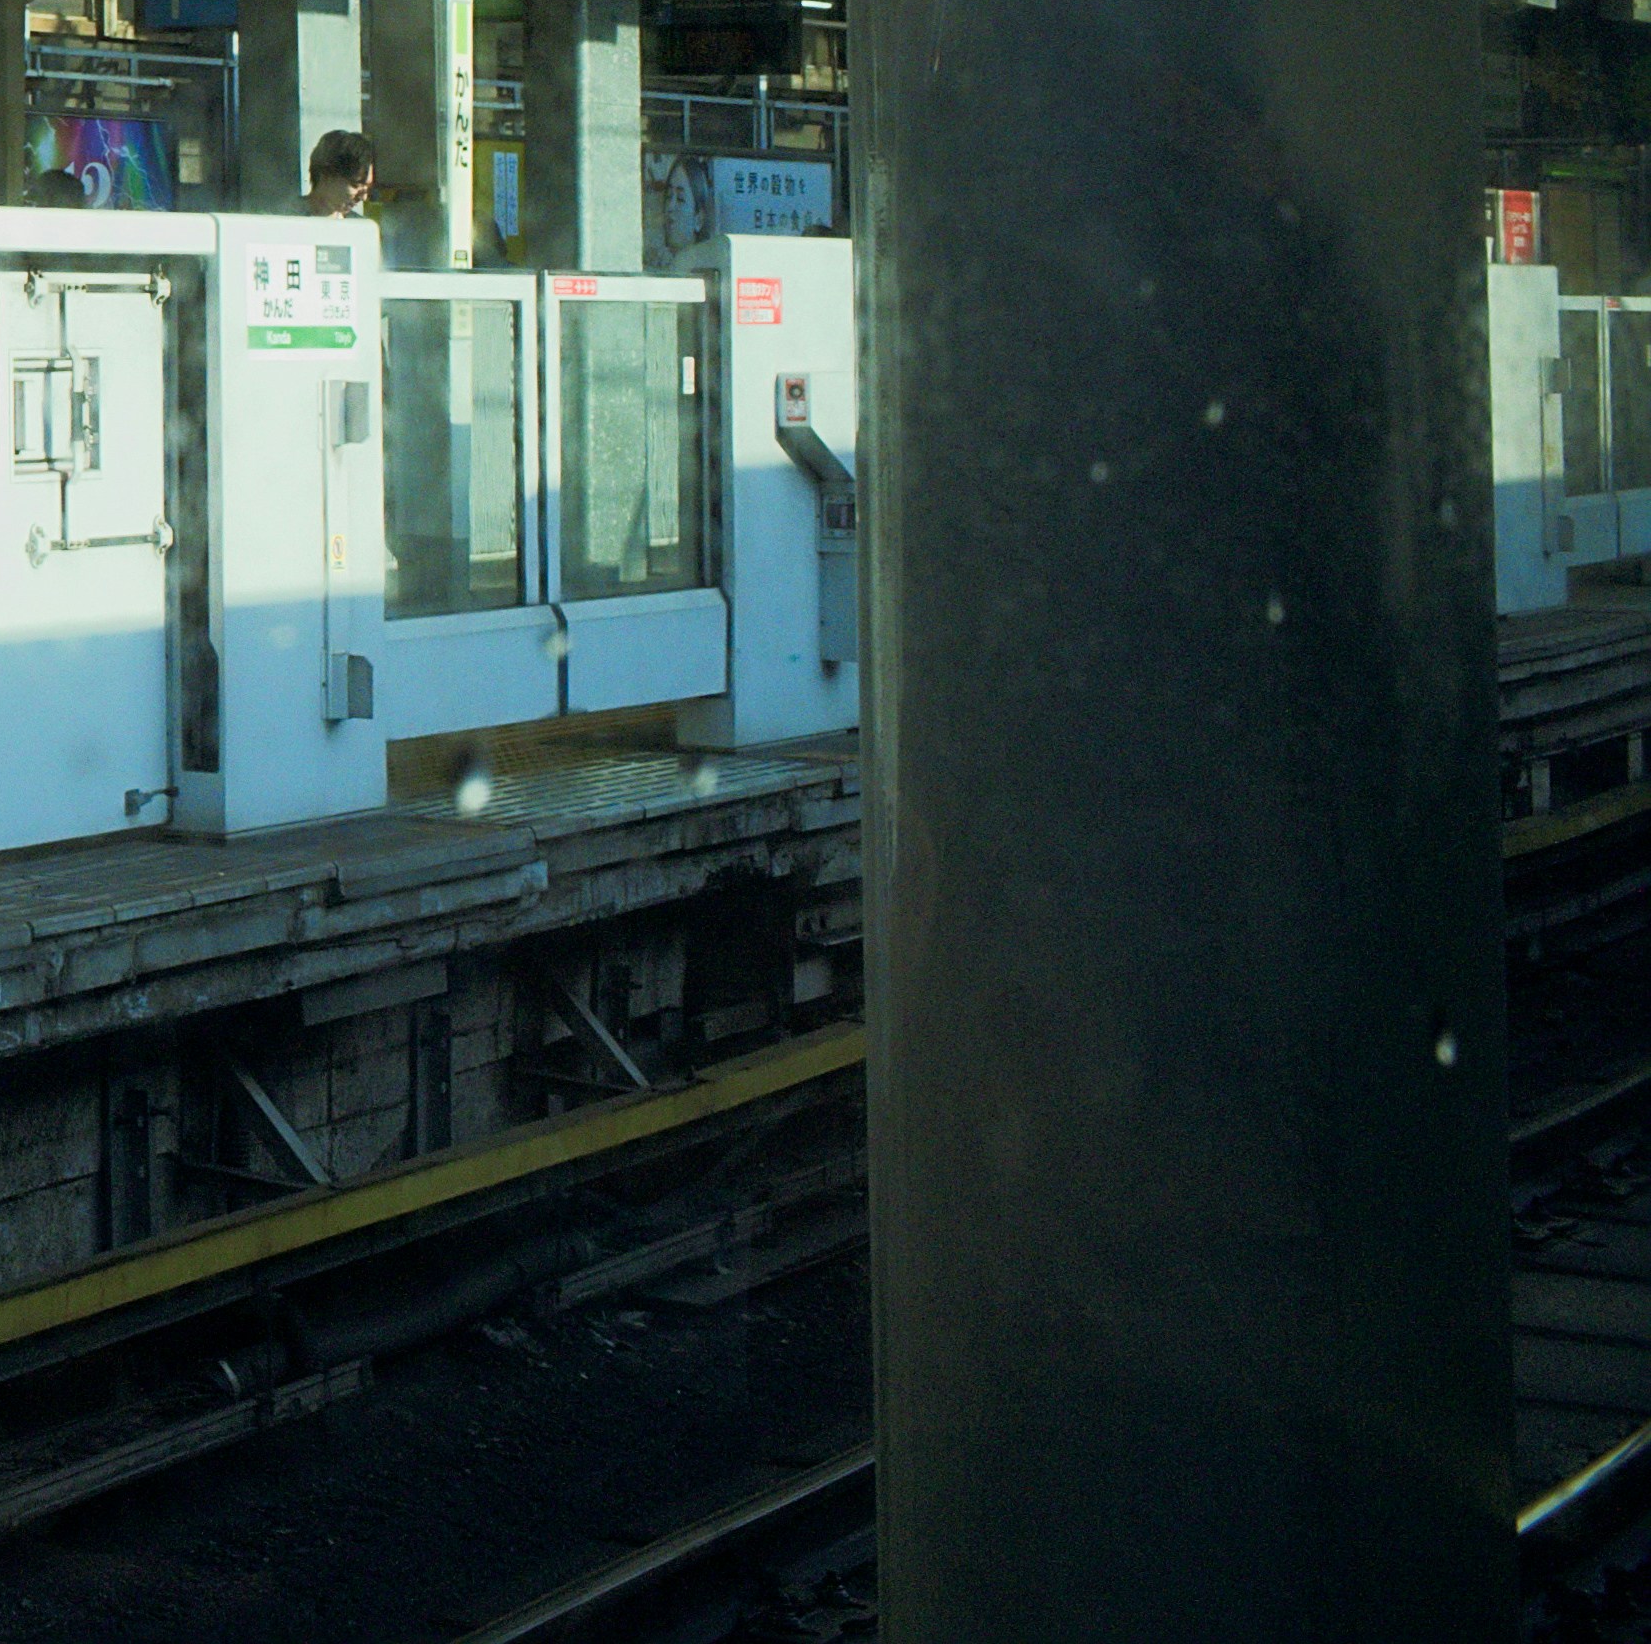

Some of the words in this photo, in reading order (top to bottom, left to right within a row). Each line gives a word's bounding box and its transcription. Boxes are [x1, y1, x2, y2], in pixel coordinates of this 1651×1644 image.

[455, 67, 469, 168] かんだ
[254, 256, 300, 290] 神田
[263, 298, 293, 318] かんだ
